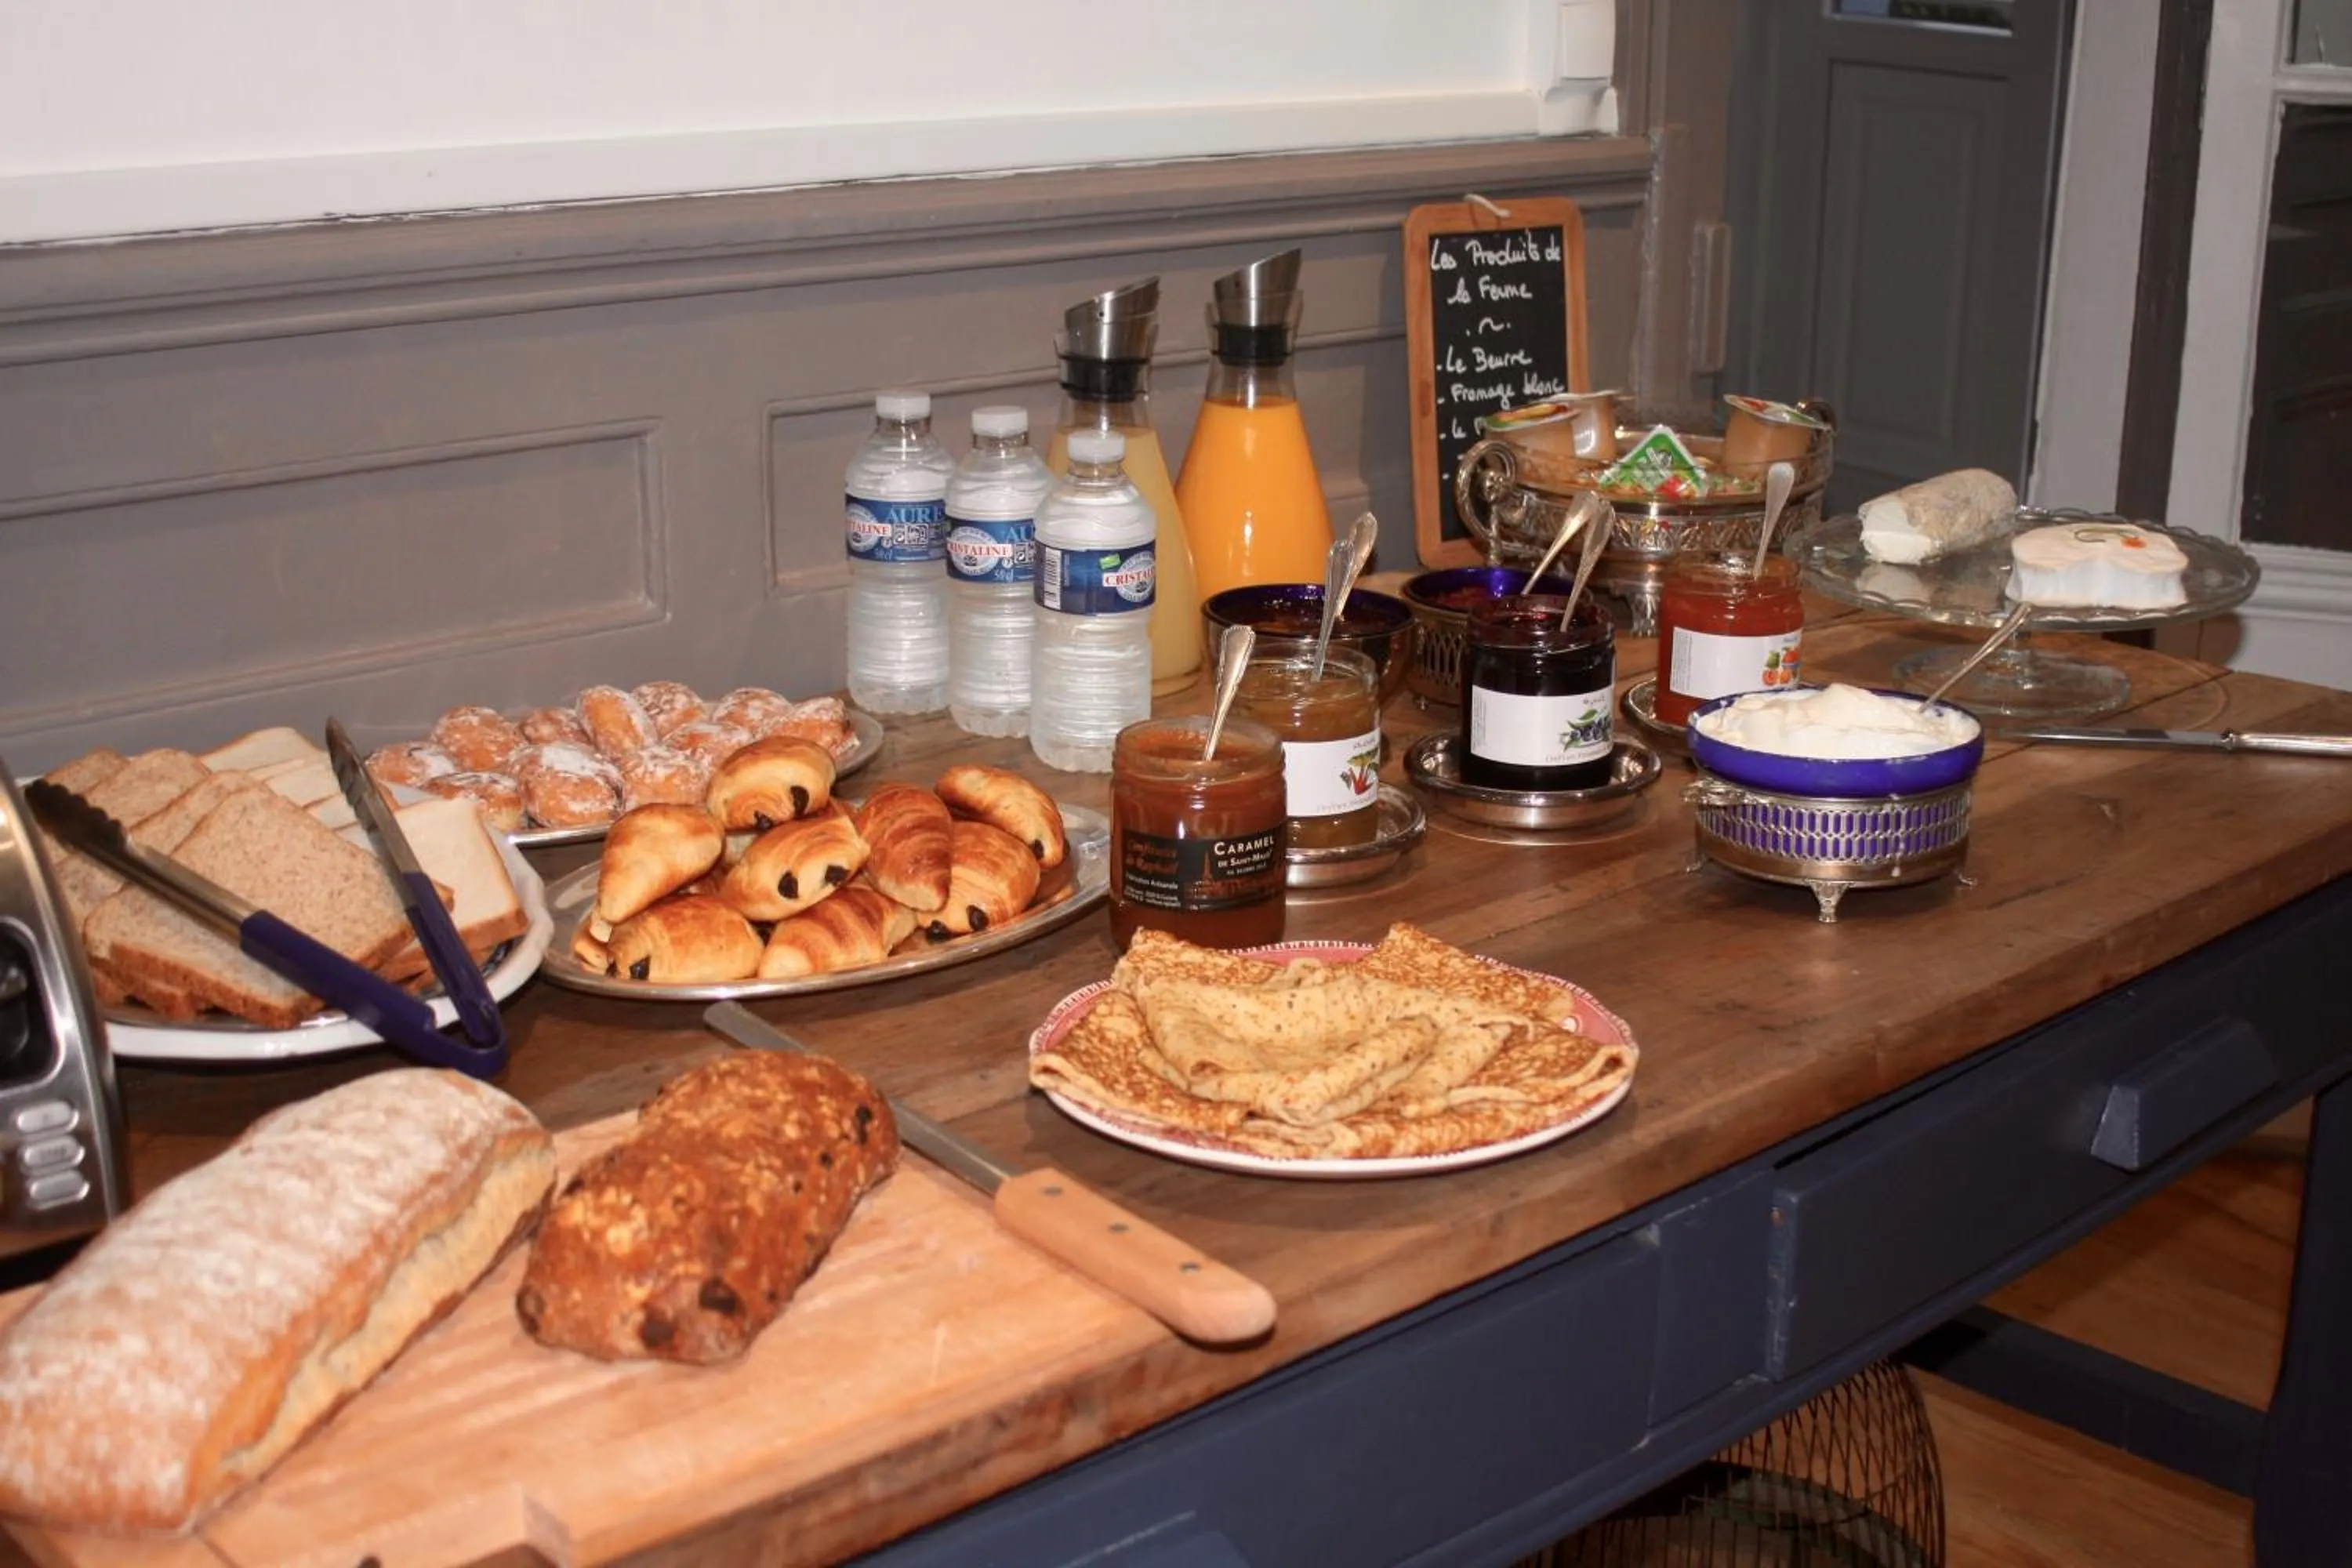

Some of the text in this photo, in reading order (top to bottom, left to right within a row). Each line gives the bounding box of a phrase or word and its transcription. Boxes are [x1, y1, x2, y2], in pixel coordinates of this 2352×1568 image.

[1431, 229, 1562, 270] Les Produits de
[1447, 275, 1533, 305] la Ferme
[1446, 345, 1533, 372] Le Beurre
[1451, 372, 1565, 410] Fromage blanc
[1214, 835, 1274, 855] CARAMEL
